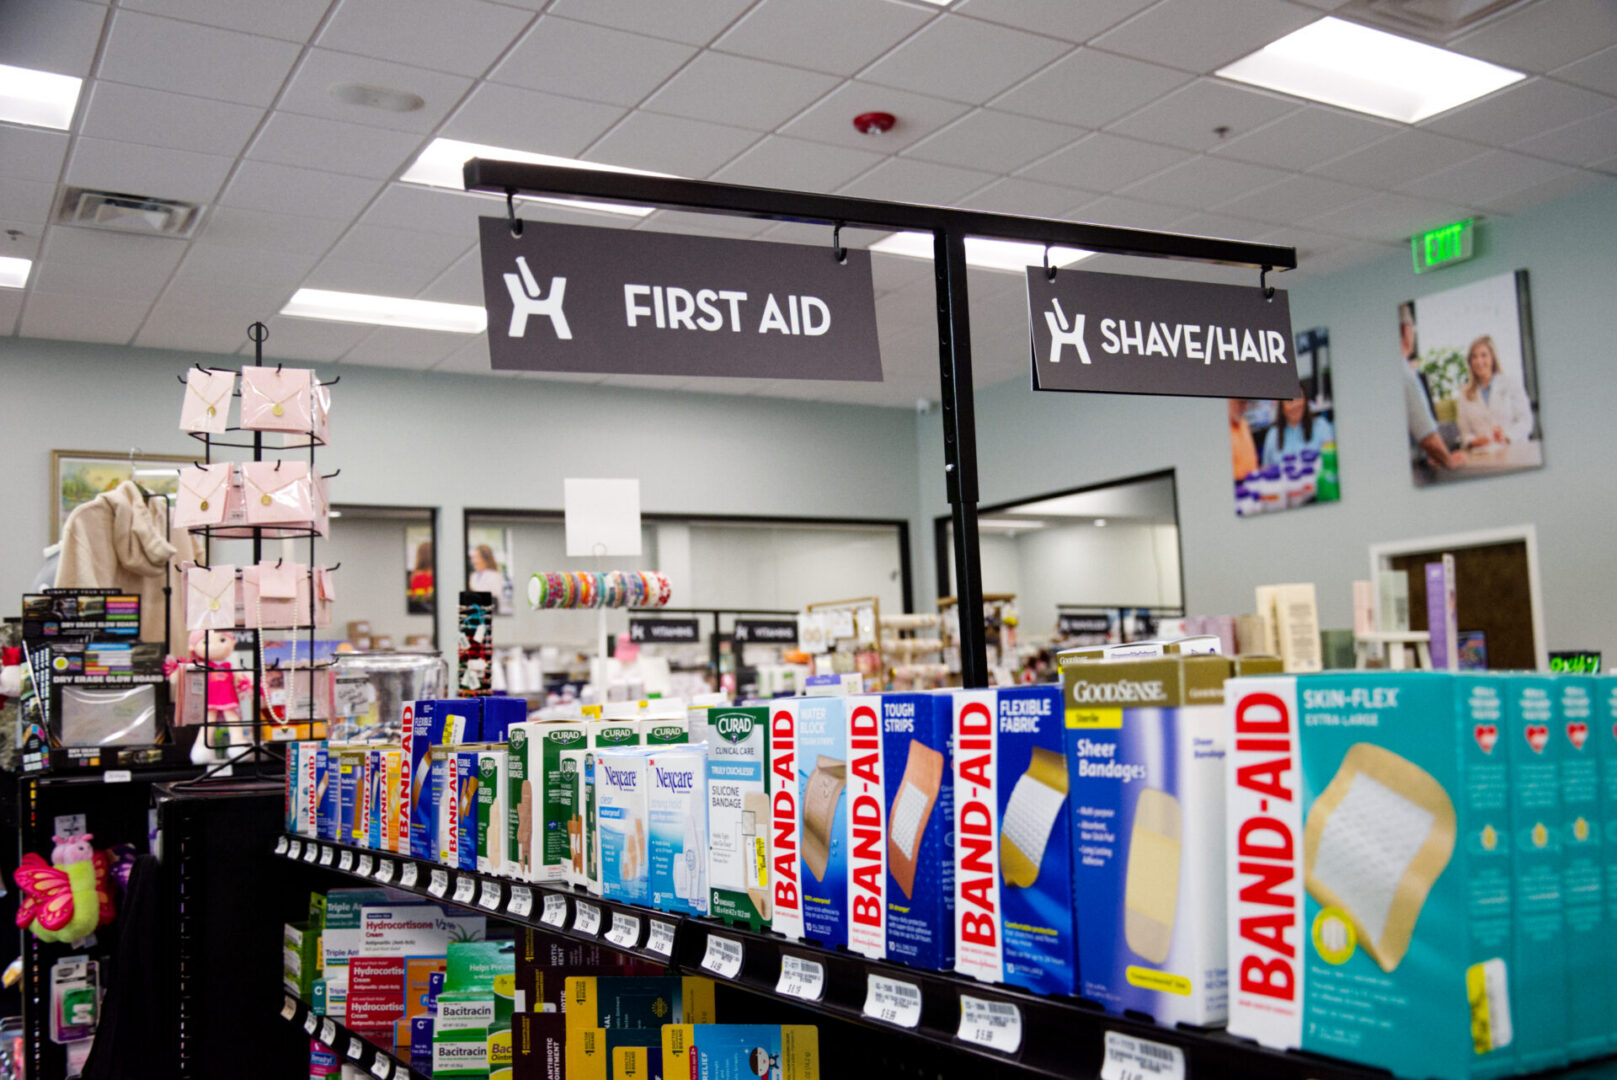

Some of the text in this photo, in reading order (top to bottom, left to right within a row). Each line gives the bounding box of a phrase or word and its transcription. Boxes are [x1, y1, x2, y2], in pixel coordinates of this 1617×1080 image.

[1424, 223, 1461, 266] EXIT
[624, 283, 832, 336] FIRST AID
[1100, 318, 1288, 364] SHAVE/HAIR
[74, 675, 104, 683] ERASE
[1303, 687, 1399, 709] SKIN-FLEX
[800, 708, 827, 721] WATER
[884, 703, 915, 717] TOUGH
[1000, 699, 1051, 716] FLEXIBLE
[414, 717, 432, 727] FLEXIBLE
[718, 717, 751, 734] CURAD
[884, 718, 915, 733] STRIPS
[1000, 716, 1040, 733] FABRIC
[1076, 713, 1099, 723] Sterile
[603, 728, 631, 738] CURAD
[653, 727, 681, 737] CURAD
[800, 721, 825, 734] BLOCK
[550, 731, 580, 740] CURAD
[715, 746, 754, 755] CLINICAL CARE
[1077, 739, 1117, 757] Sheer
[399, 705, 413, 839] BAND-AID
[1079, 759, 1146, 782] Bandages
[604, 766, 638, 791] Nexcare
[656, 767, 694, 794] Nexcare
[712, 786, 740, 796] SILICONE
[448, 758, 458, 852] BAND-AID
[712, 797, 741, 808] BANDAGE
[772, 709, 799, 910] BAND-AID
[850, 704, 882, 928] BAND-AID
[959, 701, 996, 948] BAND-AID
[1235, 691, 1296, 1002] BAND-AID
[713, 891, 719, 905] 8
[327, 903, 351, 912] Triple
[366, 921, 433, 931] Hydrocortisone
[443, 1006, 491, 1016] Bacitracin
[439, 1047, 487, 1056] Bacitracin
